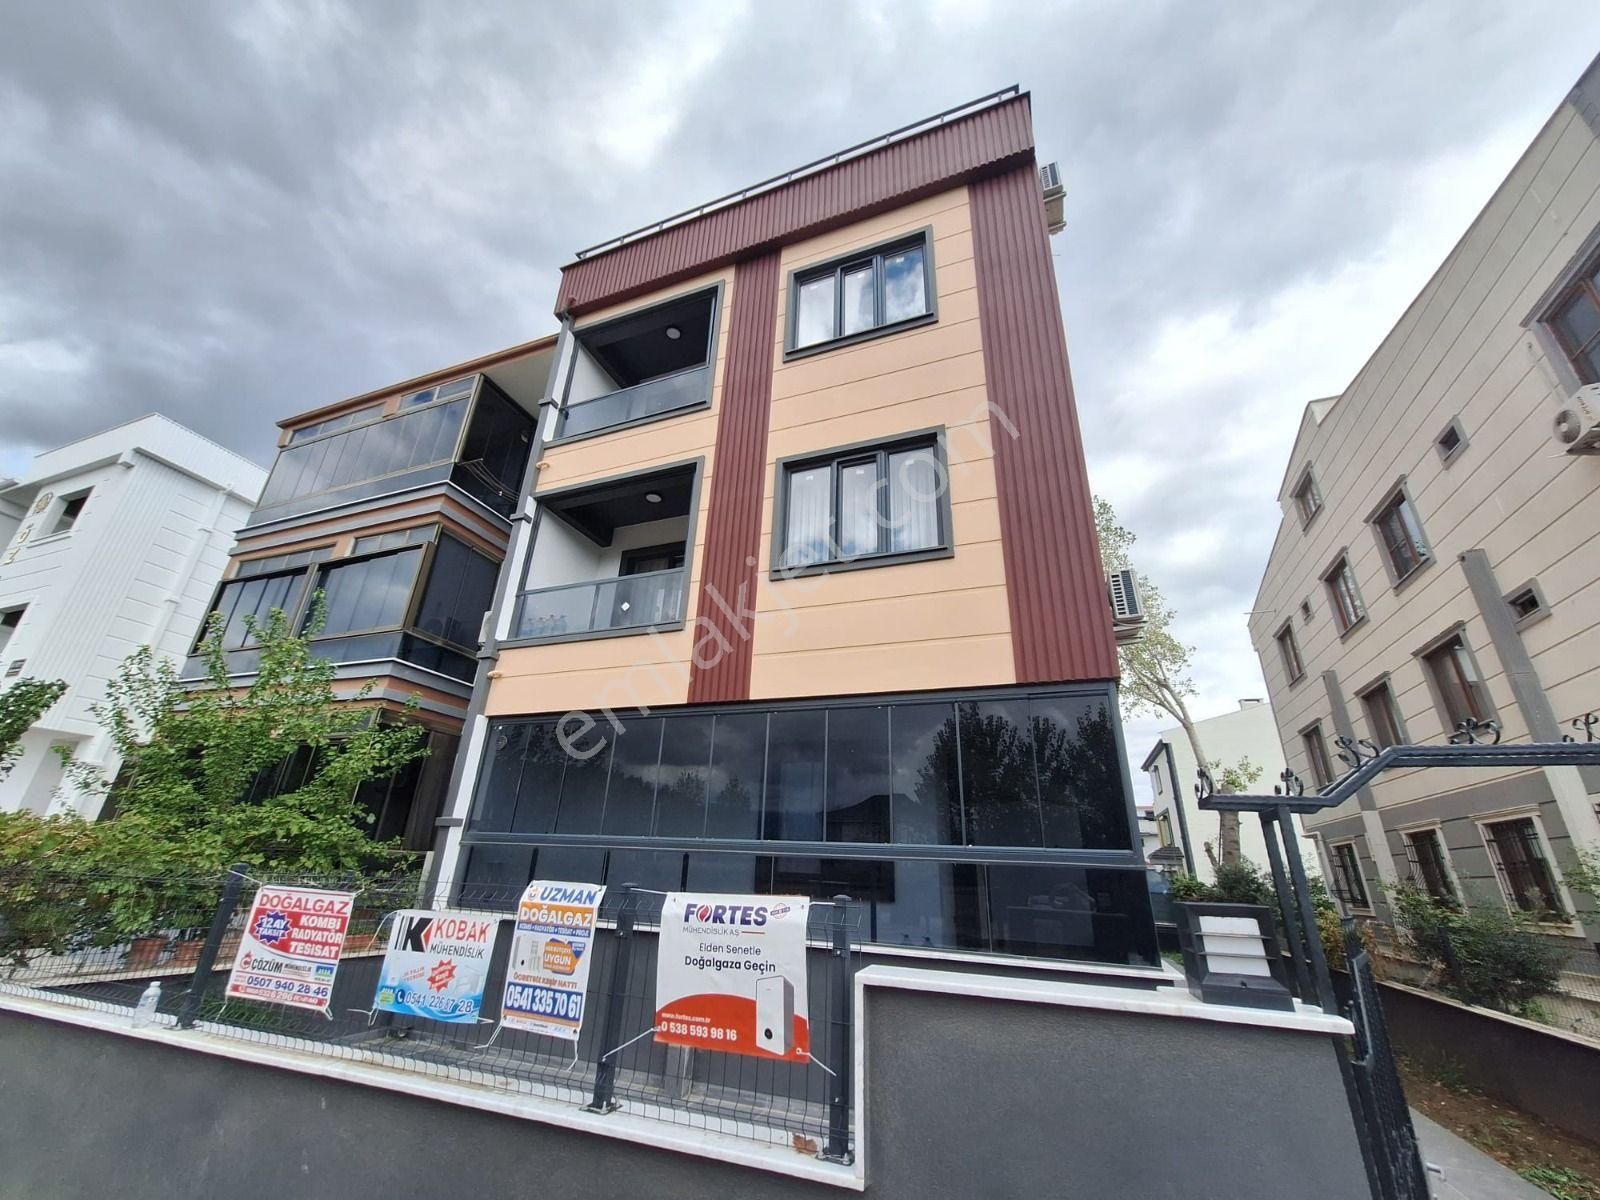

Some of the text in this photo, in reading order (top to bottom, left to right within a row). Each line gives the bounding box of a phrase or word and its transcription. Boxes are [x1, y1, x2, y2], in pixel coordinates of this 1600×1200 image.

[260, 893, 349, 914] DOĞALGAZ
[540, 886, 597, 905] UZMAN
[520, 904, 592, 927] DOĞALGAZ
[684, 903, 768, 926] FORTES
[291, 928, 343, 944] RADYATÖR
[434, 918, 491, 943] KOBAK
[430, 941, 485, 959] MÜHENDİSLİK
[544, 953, 571, 966] UYGUN
[699, 943, 761, 956] Elden Senetle
[684, 955, 776, 975] Doğalgaza Geçin
[247, 976, 272, 988] 0507
[274, 980, 295, 991] 940
[297, 983, 311, 994] 28
[313, 987, 328, 997] 46
[406, 991, 426, 1006] 0541
[458, 1000, 473, 1013] 28
[506, 984, 581, 1019] 0541 335 70 61
[661, 1021, 737, 1041] 0 538 593 98 16
